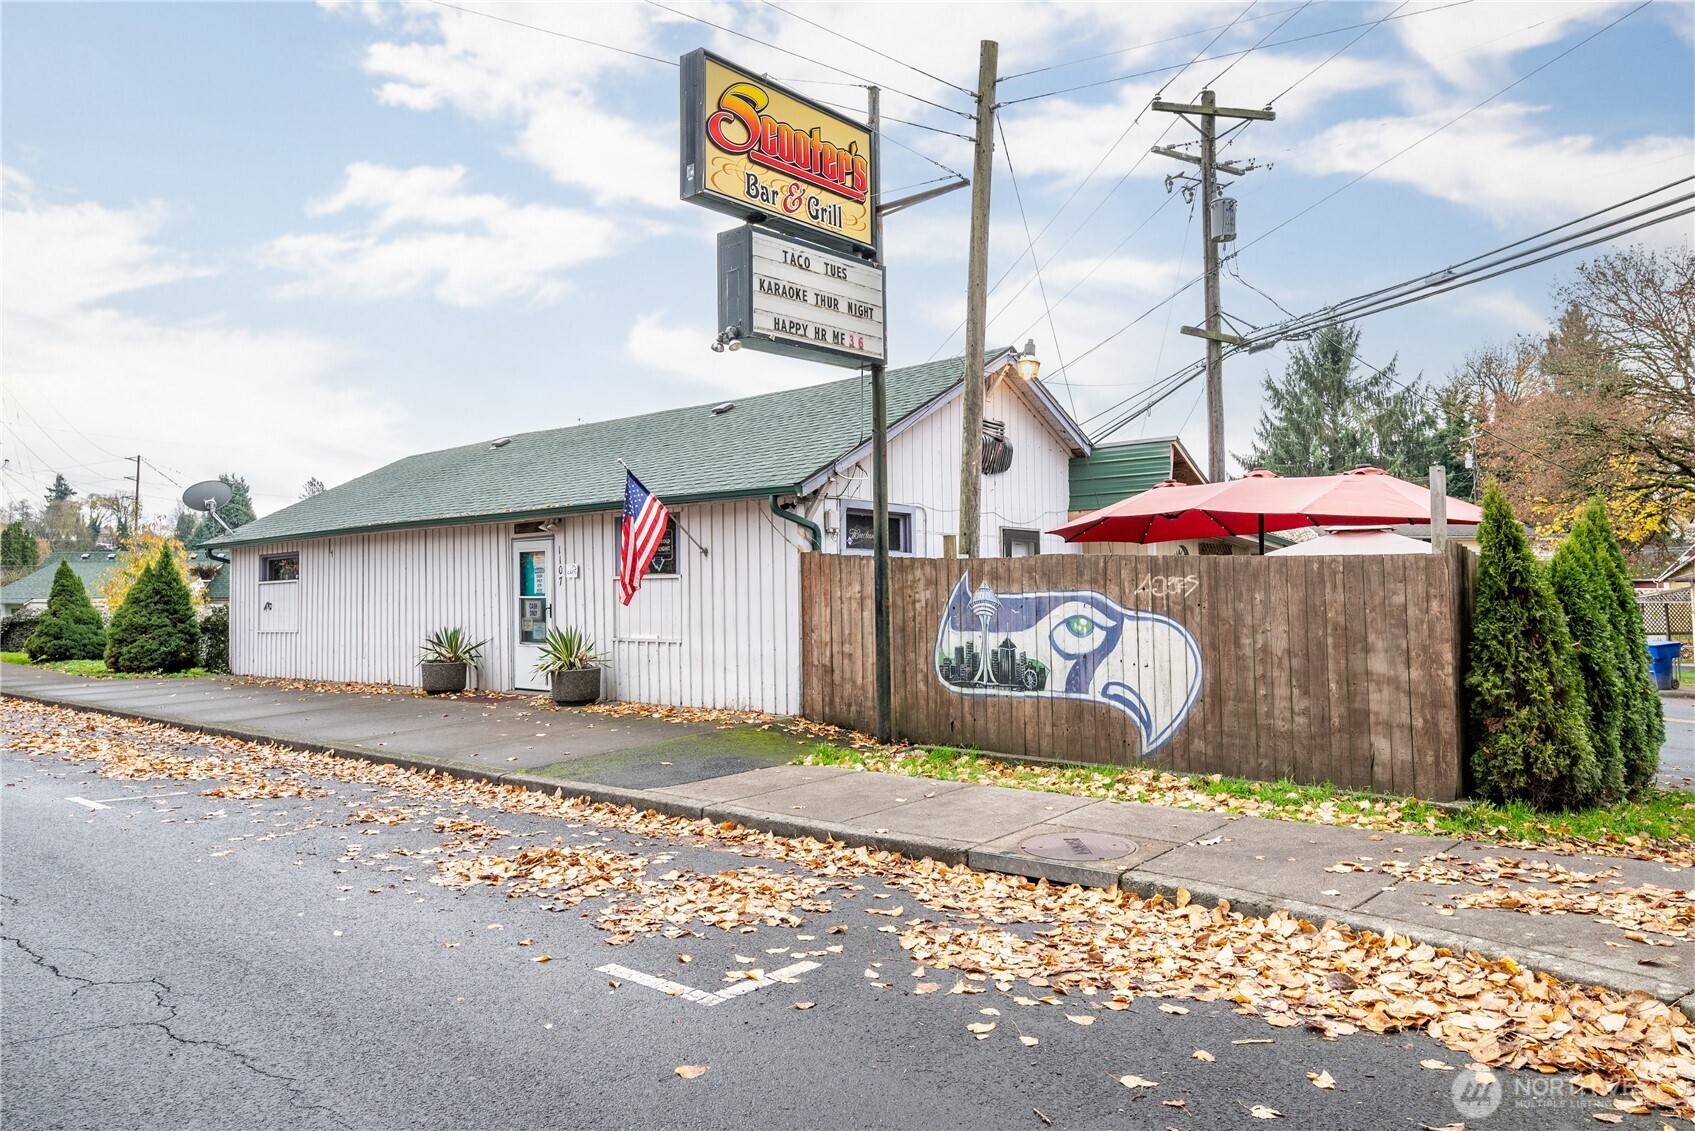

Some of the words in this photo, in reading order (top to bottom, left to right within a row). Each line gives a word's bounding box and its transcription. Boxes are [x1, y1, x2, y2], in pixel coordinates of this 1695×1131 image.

[707, 82, 868, 193] Scooter's
[745, 171, 779, 206] Bar
[782, 182, 806, 213] &
[807, 195, 843, 229] Grill
[782, 250, 811, 269] TACO
[824, 262, 848, 280] TUES
[759, 278, 808, 302] KARAOKE
[814, 293, 839, 311] THUR
[847, 301, 874, 320] NIGHT
[774, 317, 808, 337] HAPPY
[814, 326, 827, 341] HR
